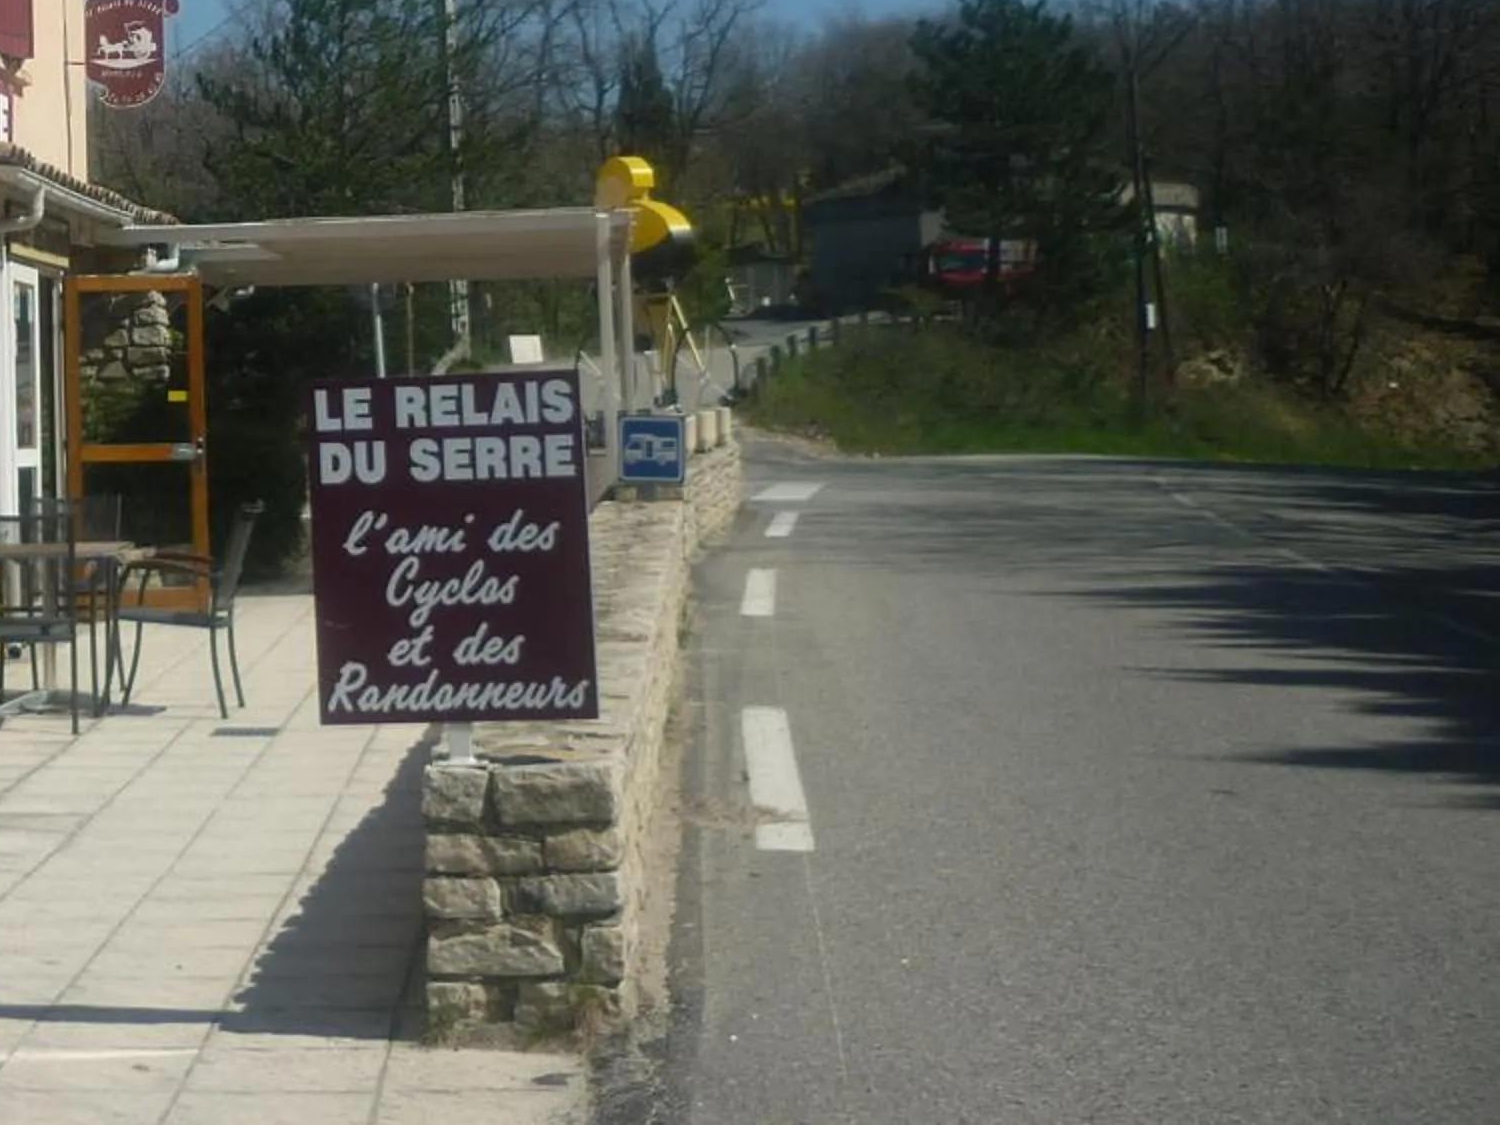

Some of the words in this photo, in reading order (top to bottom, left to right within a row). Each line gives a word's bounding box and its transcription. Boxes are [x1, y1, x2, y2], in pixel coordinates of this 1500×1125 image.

[313, 387, 373, 432] LE
[395, 380, 574, 429] RELAIS
[319, 440, 387, 485] DU
[409, 434, 576, 481] SERRE
[342, 510, 475, 555] l'ami
[487, 509, 560, 552] des
[385, 556, 520, 628] Cyclos
[387, 625, 433, 667] et
[452, 622, 526, 664] des
[328, 661, 590, 714] Randonneurs
